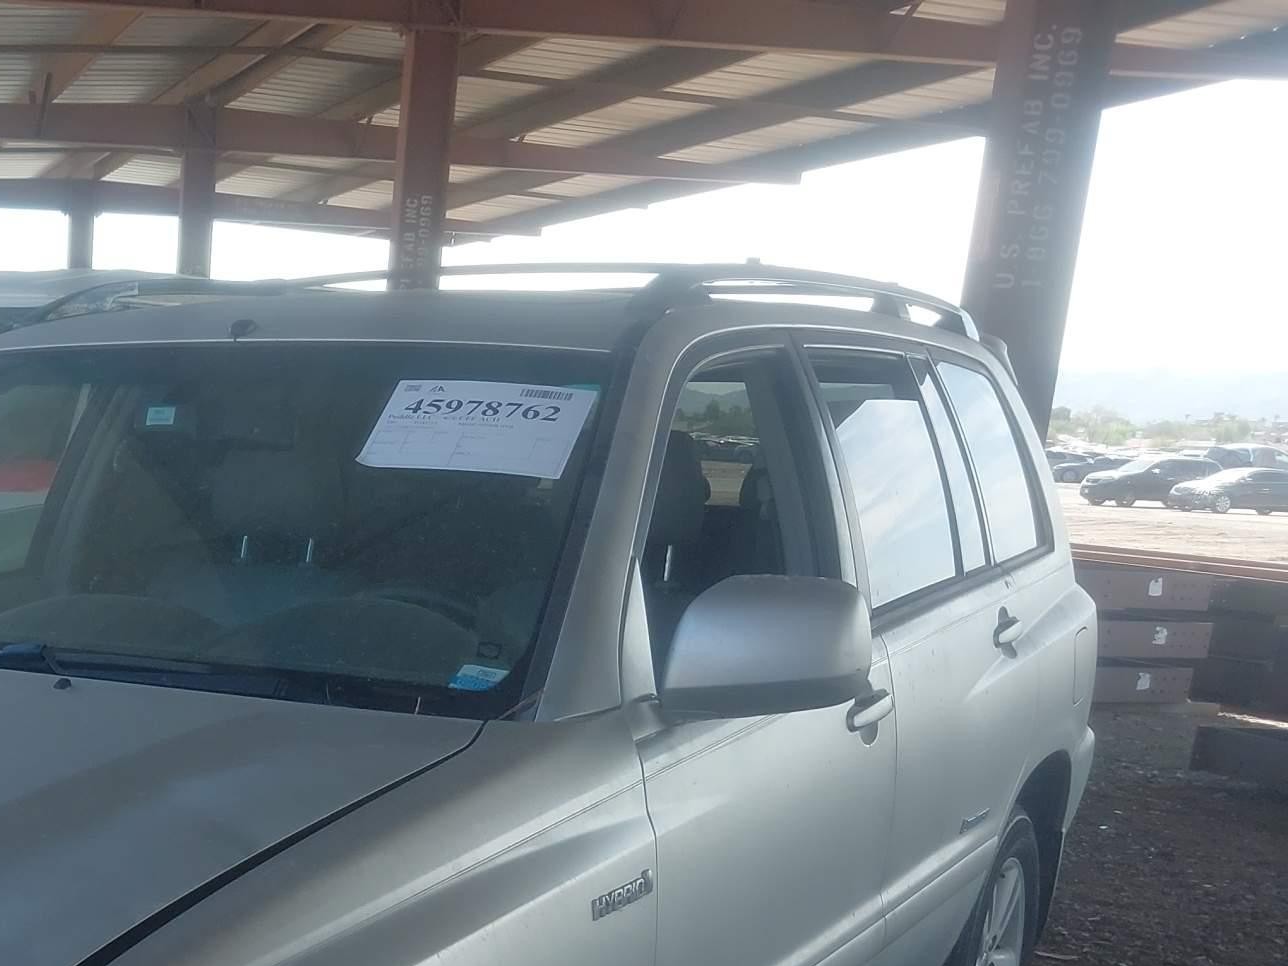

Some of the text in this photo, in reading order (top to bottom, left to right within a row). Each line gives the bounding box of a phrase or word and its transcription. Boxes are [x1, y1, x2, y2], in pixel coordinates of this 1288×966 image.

[1007, 99, 1044, 216] PREFAB
[1028, 24, 1057, 81] INC.
[404, 398, 562, 423] 45978762
[593, 872, 650, 919] HYBRID
